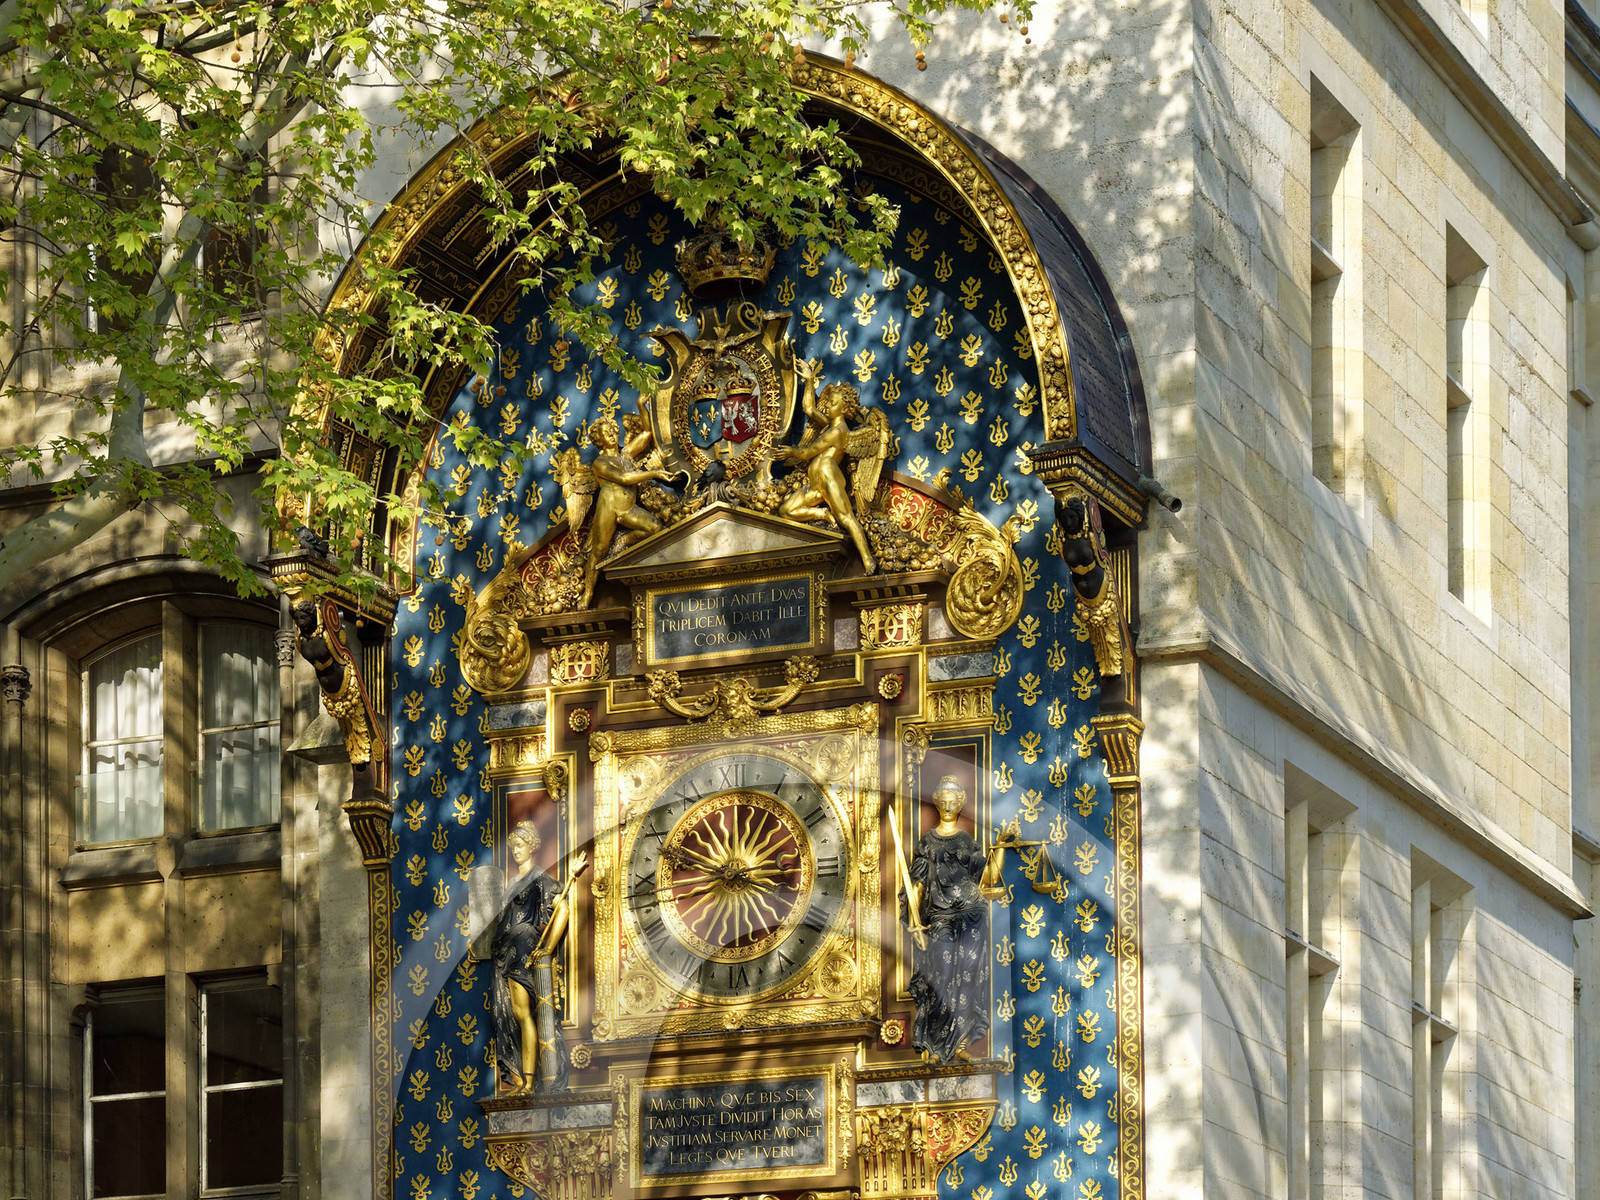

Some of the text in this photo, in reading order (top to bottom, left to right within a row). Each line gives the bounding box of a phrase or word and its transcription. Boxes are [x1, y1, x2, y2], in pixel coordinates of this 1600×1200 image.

[658, 586, 806, 618] QVI DEDIT ANTE DVAS
[658, 604, 807, 633] TRIPLICEM DABIT ILLE
[694, 627, 771, 648] CORONAM
[718, 763, 746, 790] XII
[650, 1096, 715, 1112] MACHINA
[760, 1091, 782, 1104] BIS
[785, 1087, 816, 1102] SEX
[720, 1110, 768, 1125] DIVIDIT
[772, 1106, 822, 1121] HORAS
[646, 1124, 823, 1149] JVSTITIAM SERVARE MONET
[670, 1150, 713, 1165] LEGES
[751, 1145, 794, 1160] TVERI
